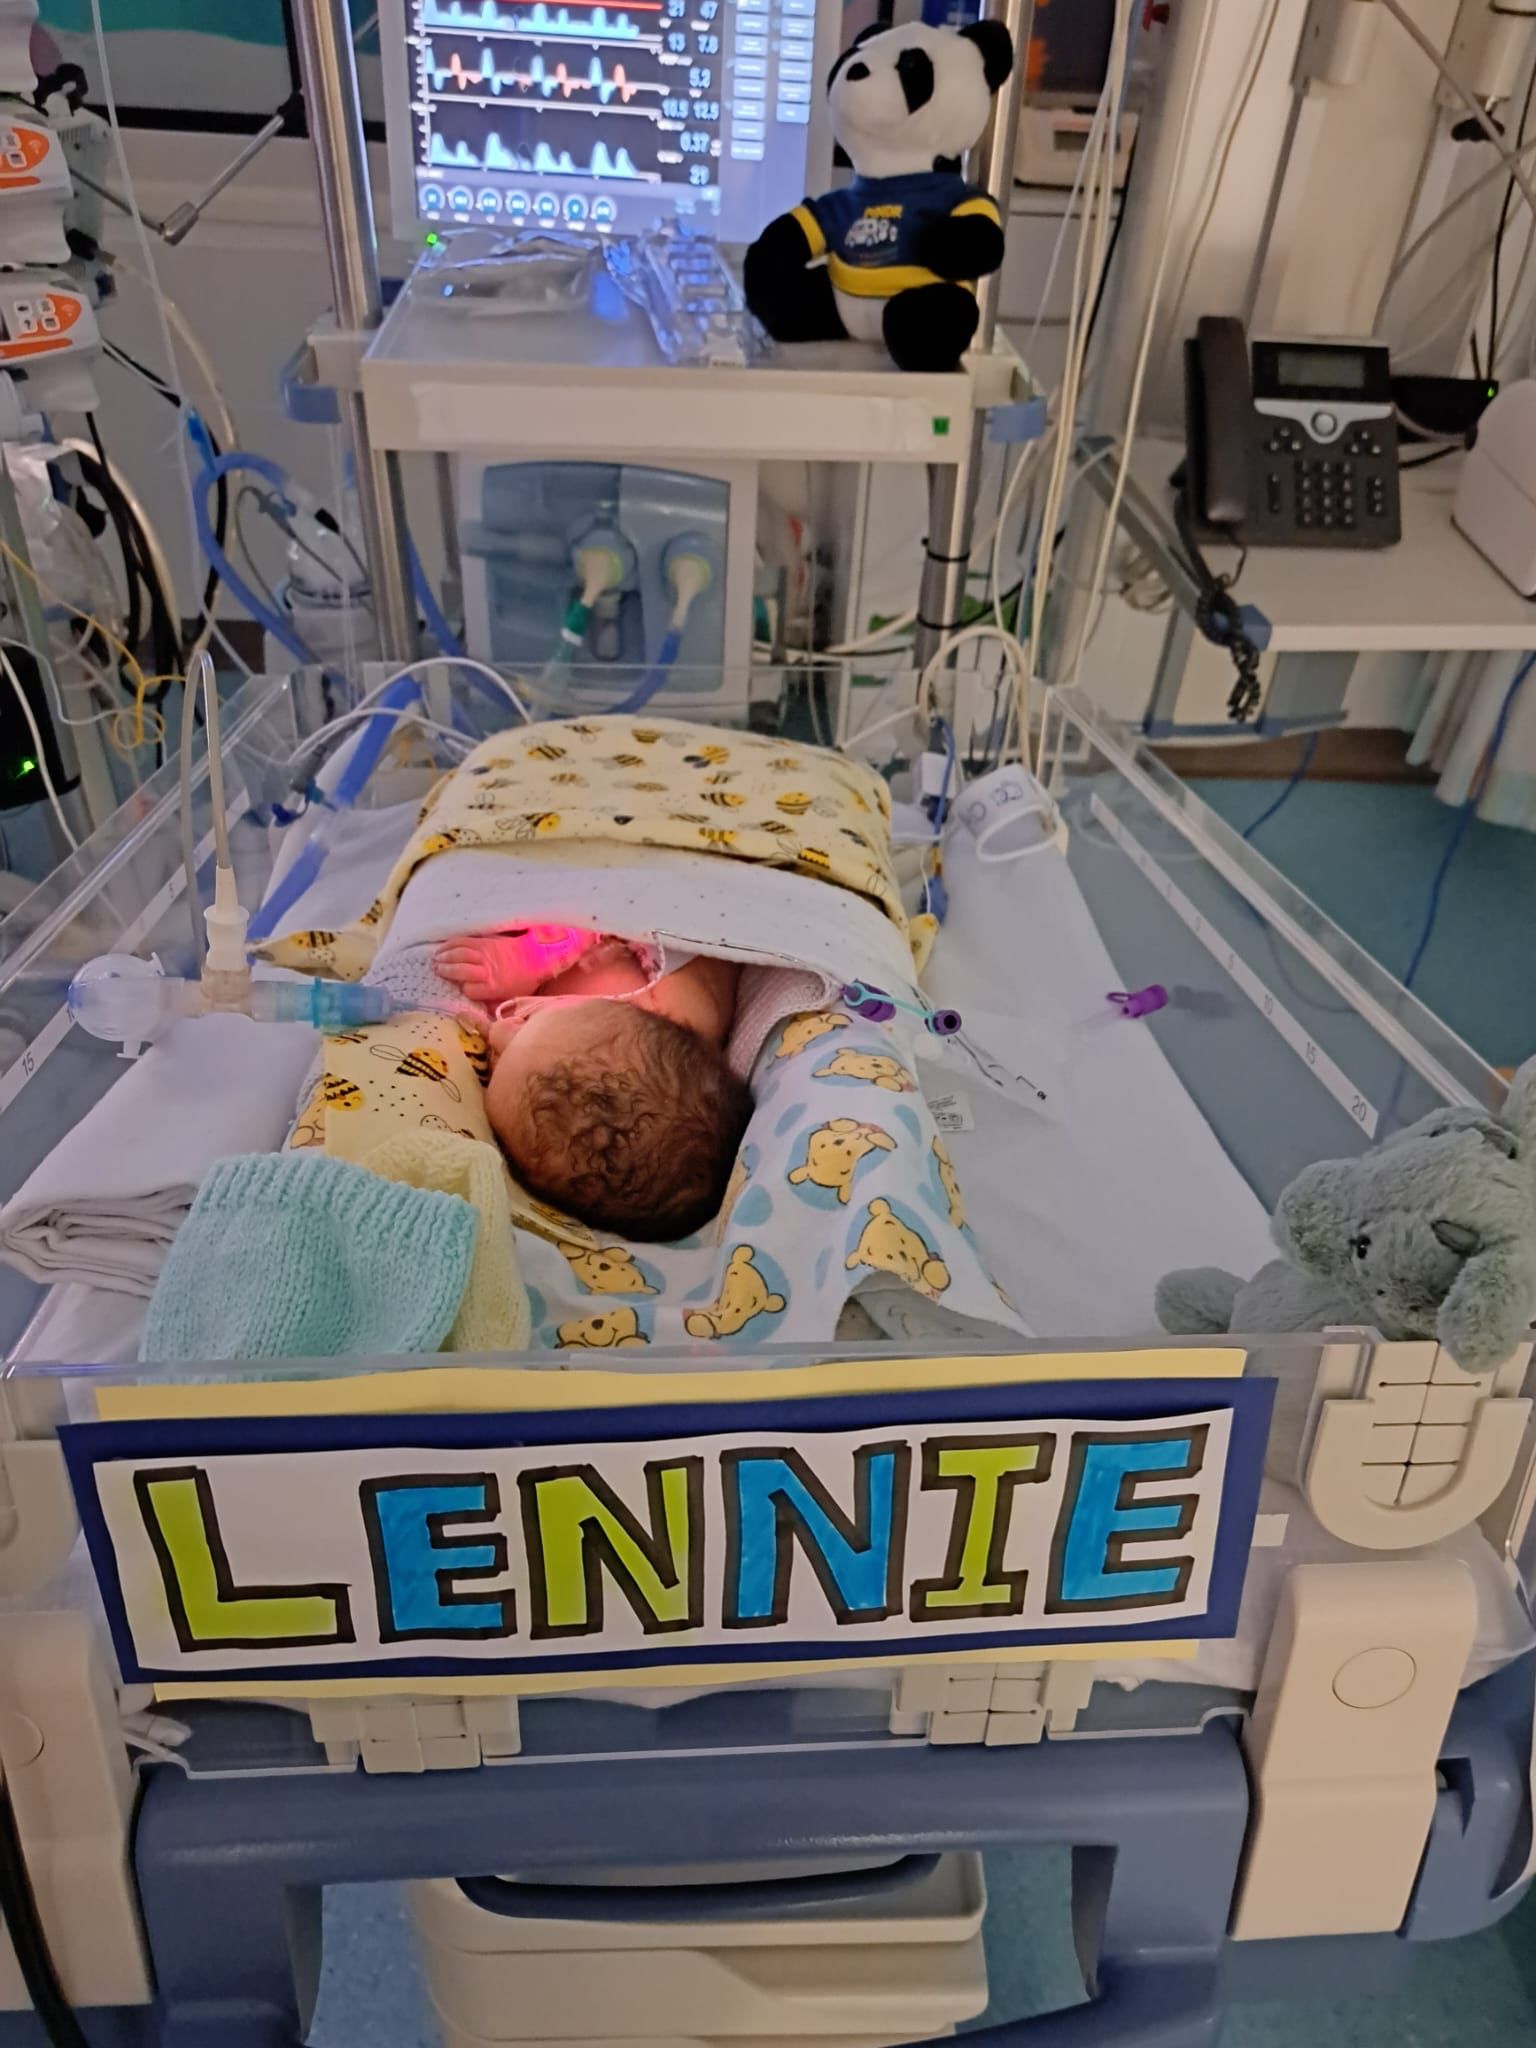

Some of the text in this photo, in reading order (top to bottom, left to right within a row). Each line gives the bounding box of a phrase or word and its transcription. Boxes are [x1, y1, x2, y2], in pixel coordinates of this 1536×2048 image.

[1262, 994, 1274, 1016] 10
[21, 1051, 35, 1077] 15
[1304, 1041, 1317, 1065] 15
[1350, 1094, 1367, 1123] 20
[134, 1424, 1212, 1653] LENNIE
